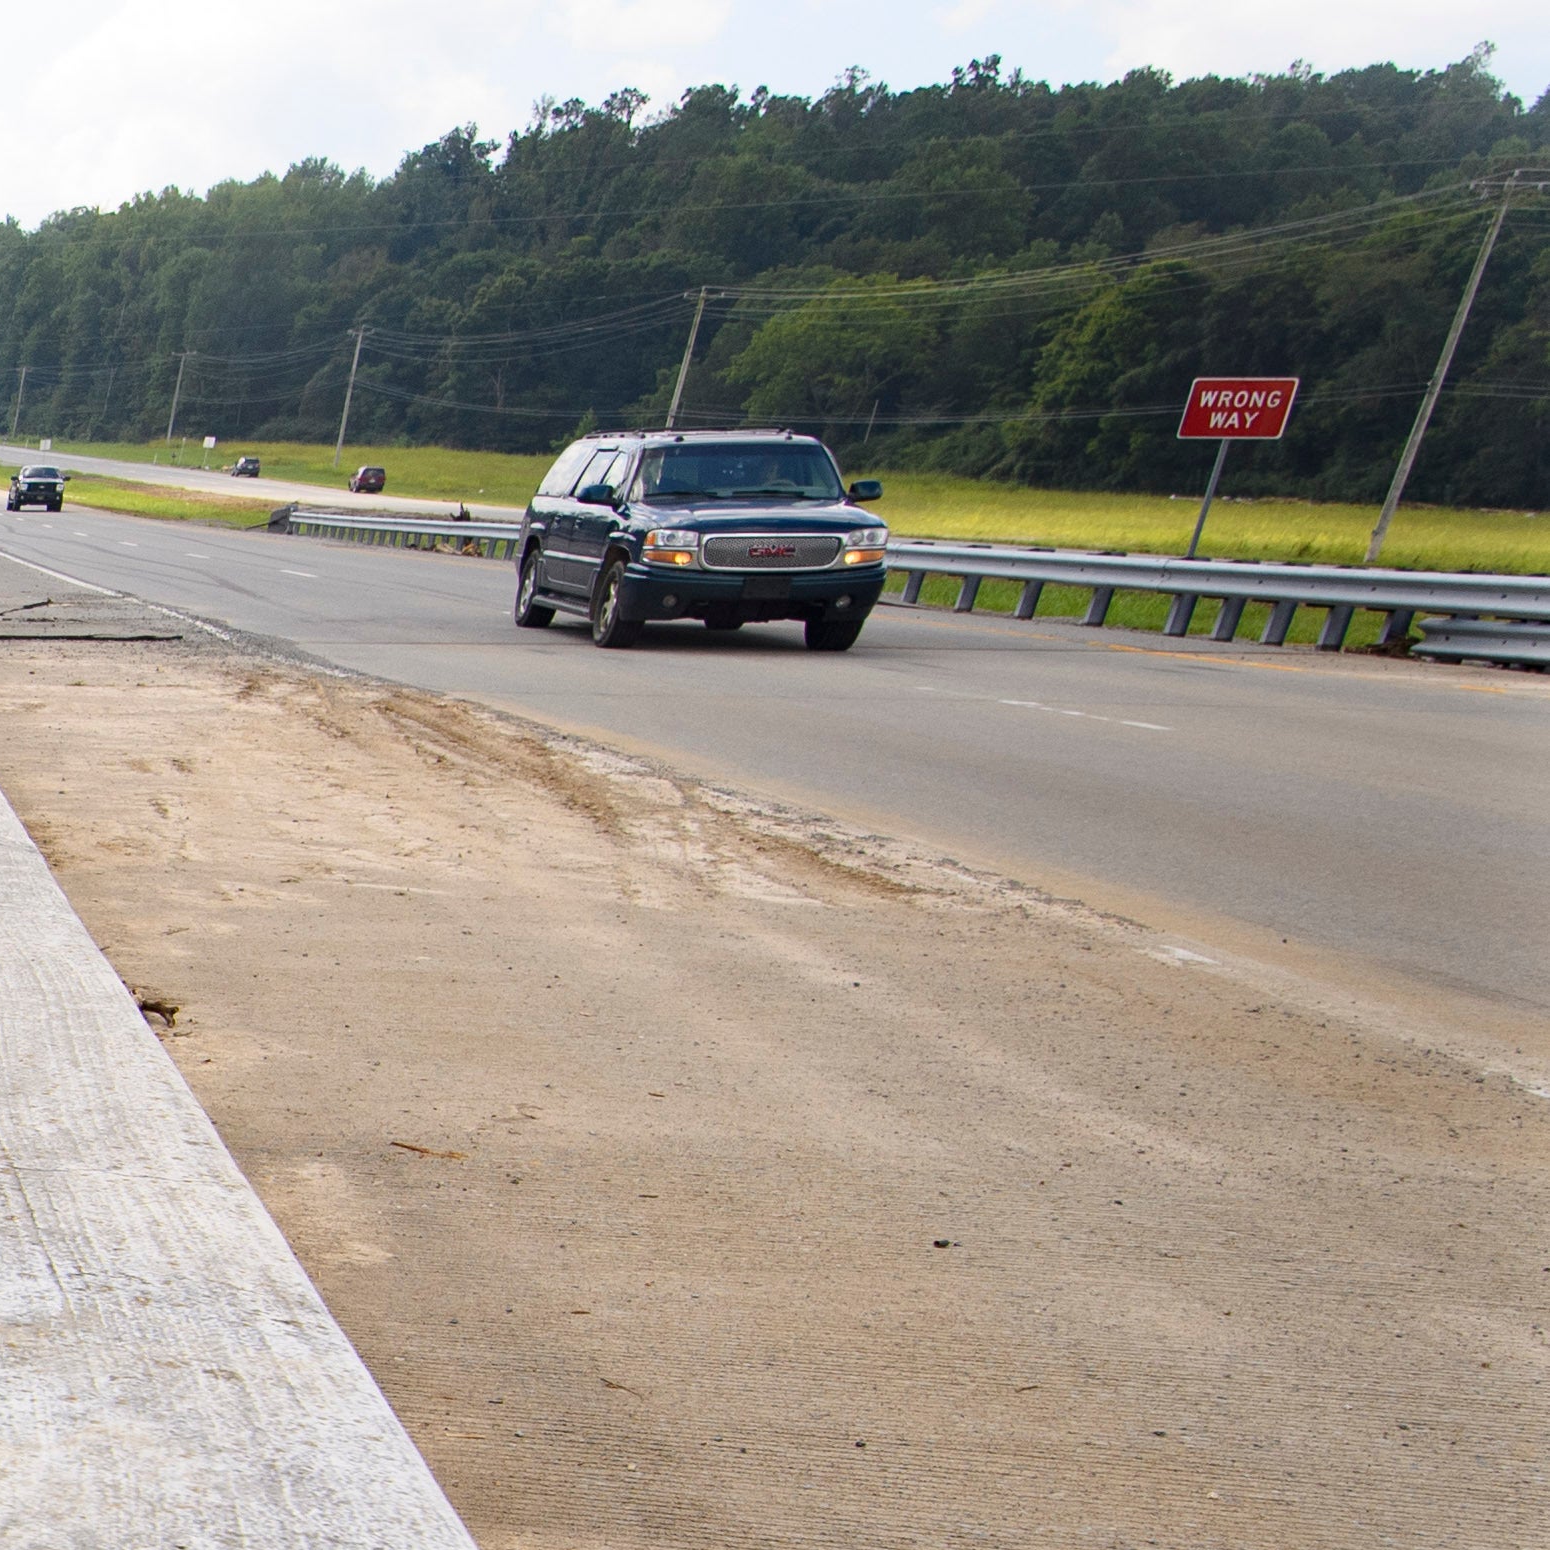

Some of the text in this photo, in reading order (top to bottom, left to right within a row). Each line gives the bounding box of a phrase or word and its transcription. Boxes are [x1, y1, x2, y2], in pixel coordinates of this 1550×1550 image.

[1200, 390, 1282, 408] WRONG
[1209, 411, 1259, 429] WAY
[748, 545, 797, 558] GMC
